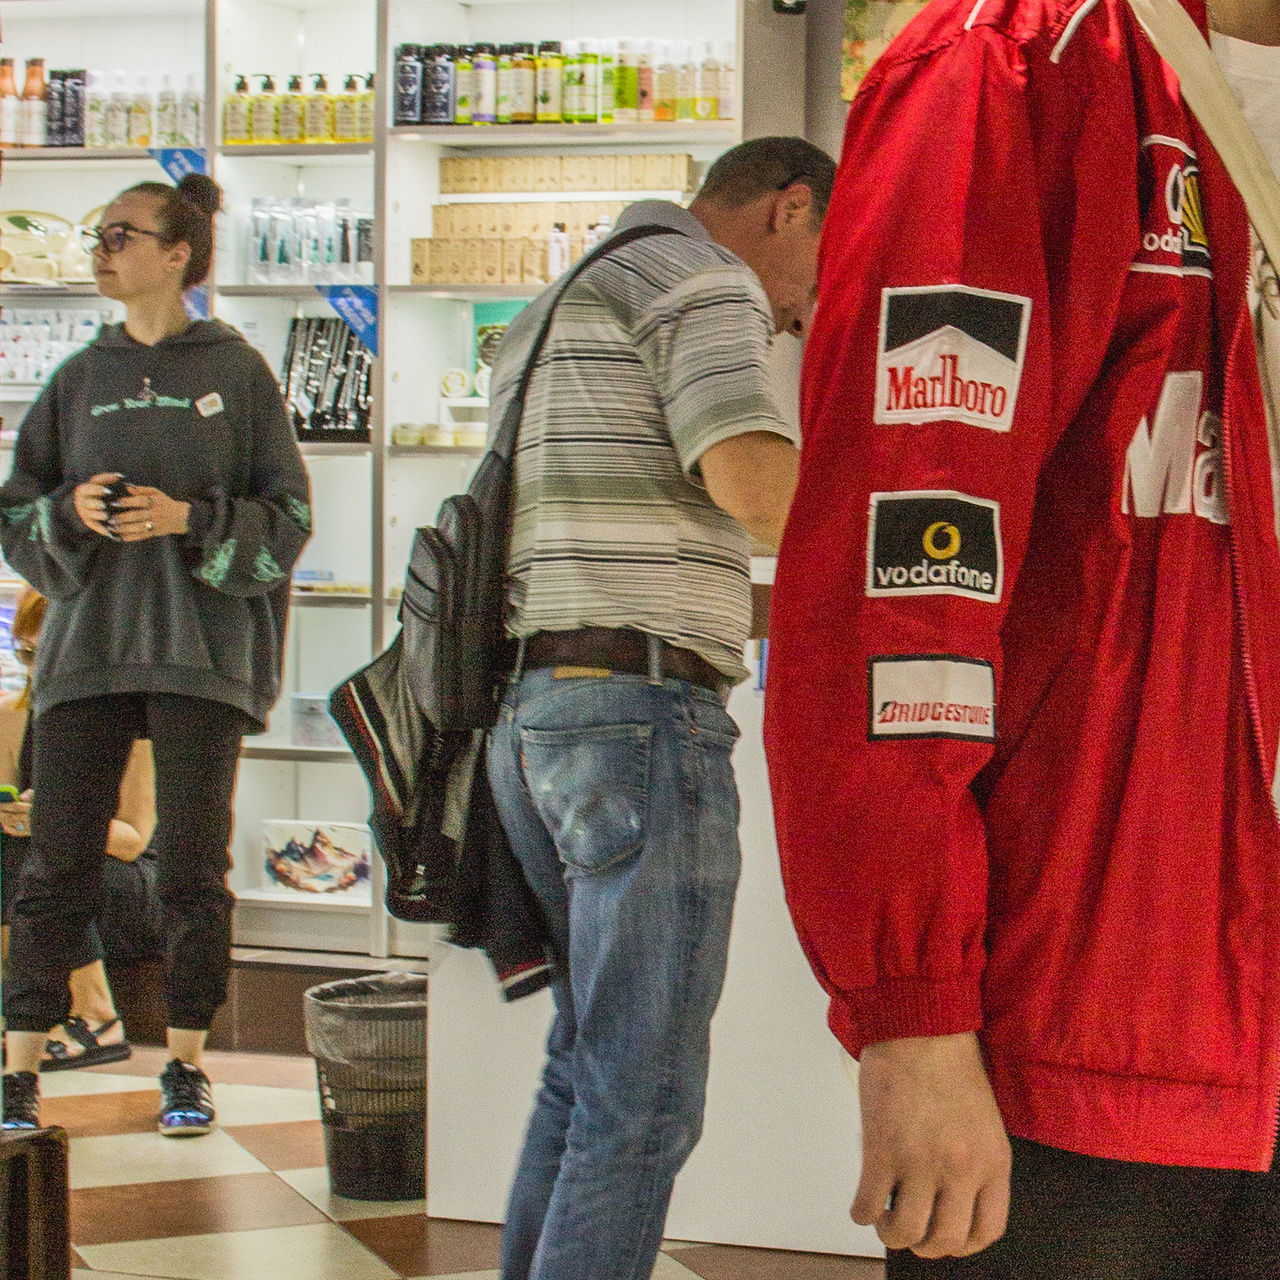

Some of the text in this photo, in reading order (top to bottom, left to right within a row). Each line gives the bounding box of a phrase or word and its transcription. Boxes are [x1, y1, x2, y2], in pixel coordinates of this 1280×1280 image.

[886, 354, 1007, 418] Marlboro
[877, 558, 994, 590] vodafone
[878, 700, 990, 726] BRIDGESTONE
